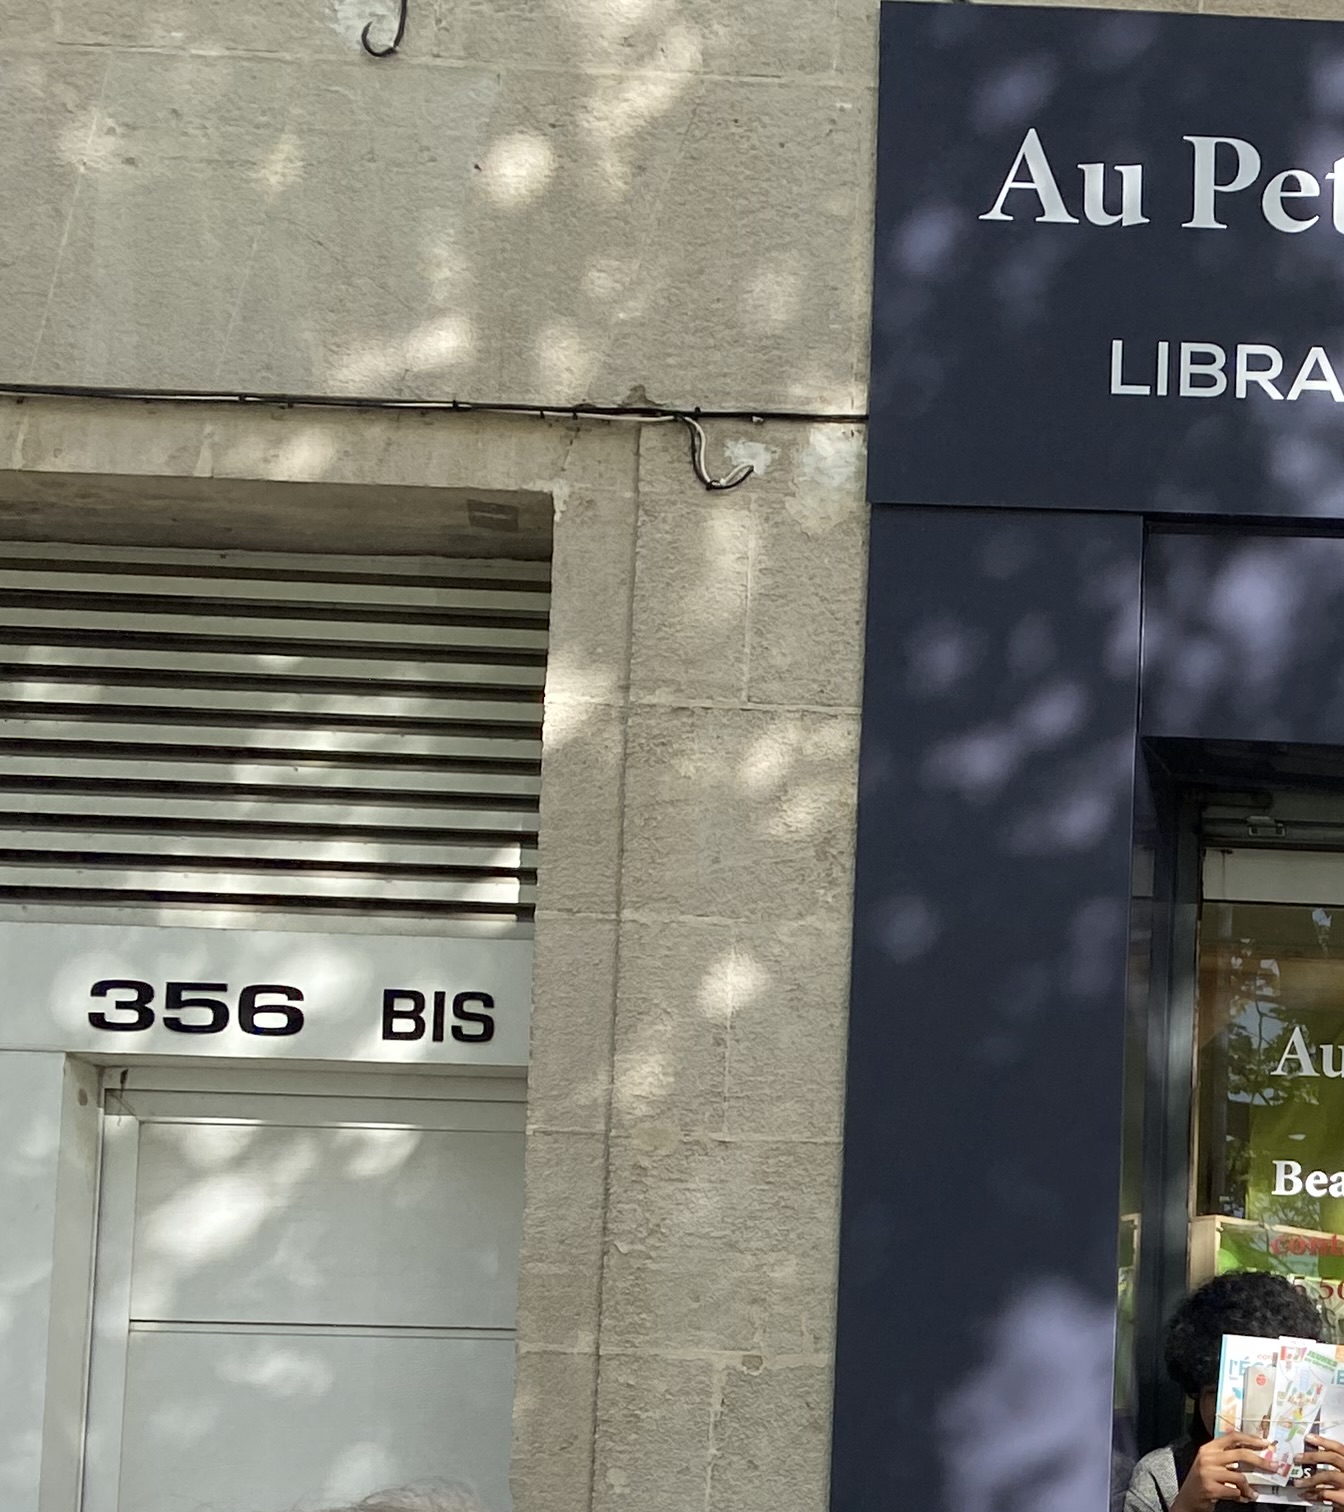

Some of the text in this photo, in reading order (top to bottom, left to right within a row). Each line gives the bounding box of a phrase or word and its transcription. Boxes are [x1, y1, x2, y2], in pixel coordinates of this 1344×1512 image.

[978, 127, 1149, 227] Au
[88, 979, 495, 1044] 356 BIS
